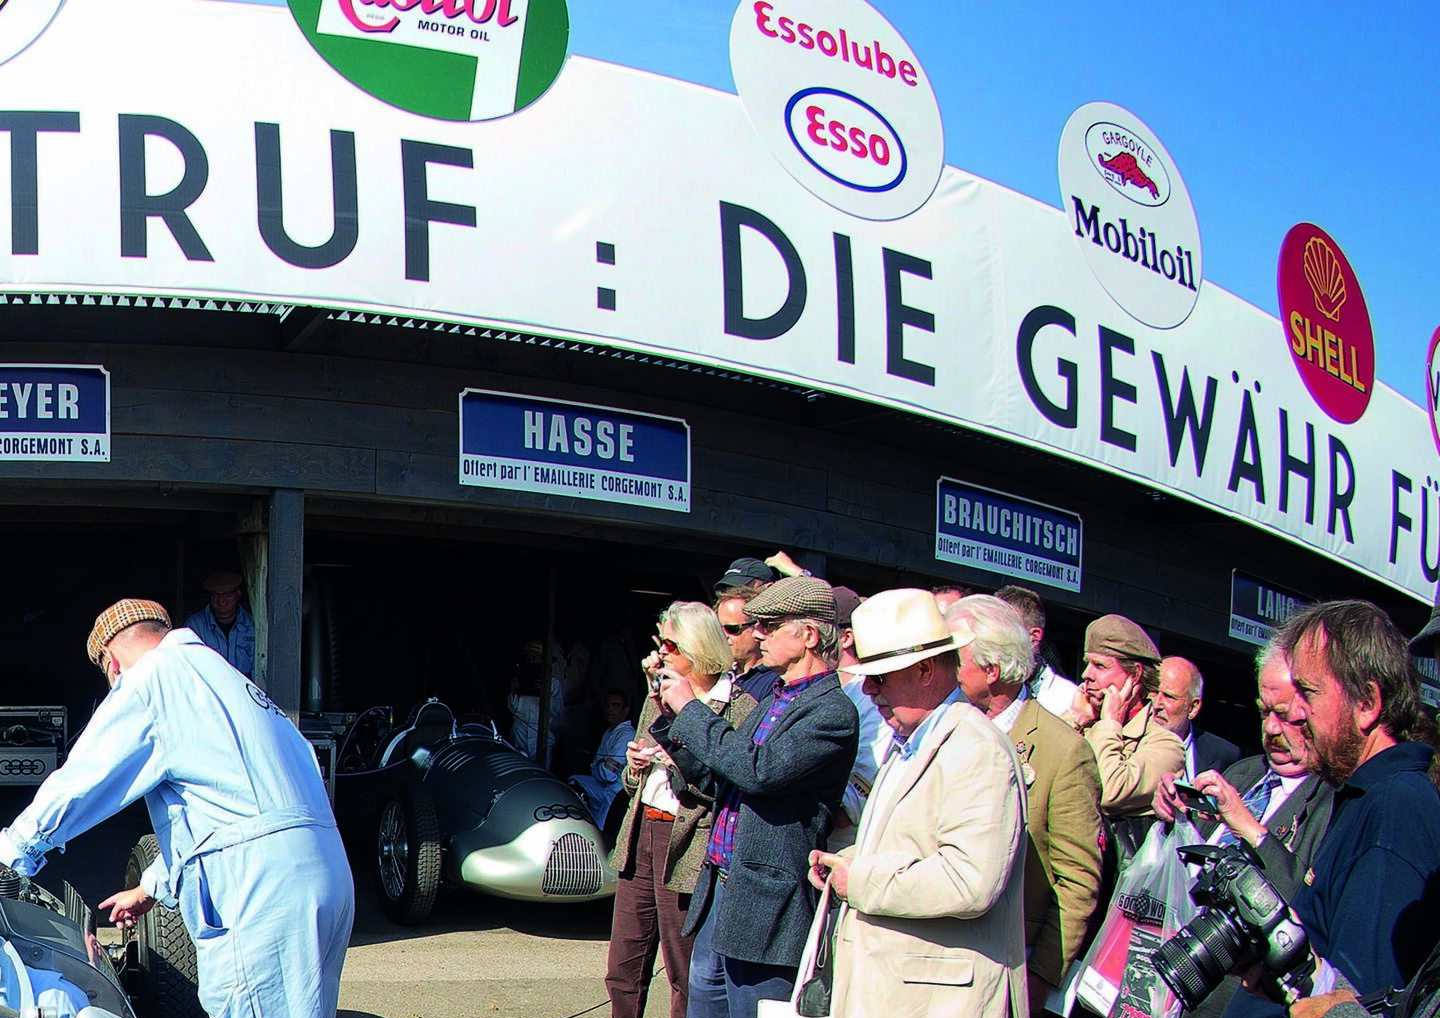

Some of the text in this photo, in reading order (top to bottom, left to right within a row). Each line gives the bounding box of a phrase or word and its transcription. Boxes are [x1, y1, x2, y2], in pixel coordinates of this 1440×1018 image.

[417, 20, 490, 42] MOTOR OIL
[753, 1, 918, 87] Essolube
[1102, 131, 1153, 168] GARGOYLE
[1071, 195, 1197, 292] Mobiloil
[719, 200, 936, 387] DIE
[1016, 305, 1356, 544] GEWÄHR
[1289, 310, 1368, 395] SHELL
[81, 439, 105, 456] S.A.
[524, 410, 634, 463] HASSE
[463, 459, 496, 478] Offert
[500, 465, 521, 480] par
[601, 475, 663, 499] CORGEMONT
[667, 485, 687, 503] S.A.
[944, 493, 1077, 556] BRAUCHITSCH
[1025, 558, 1064, 580] CORGEMONT
